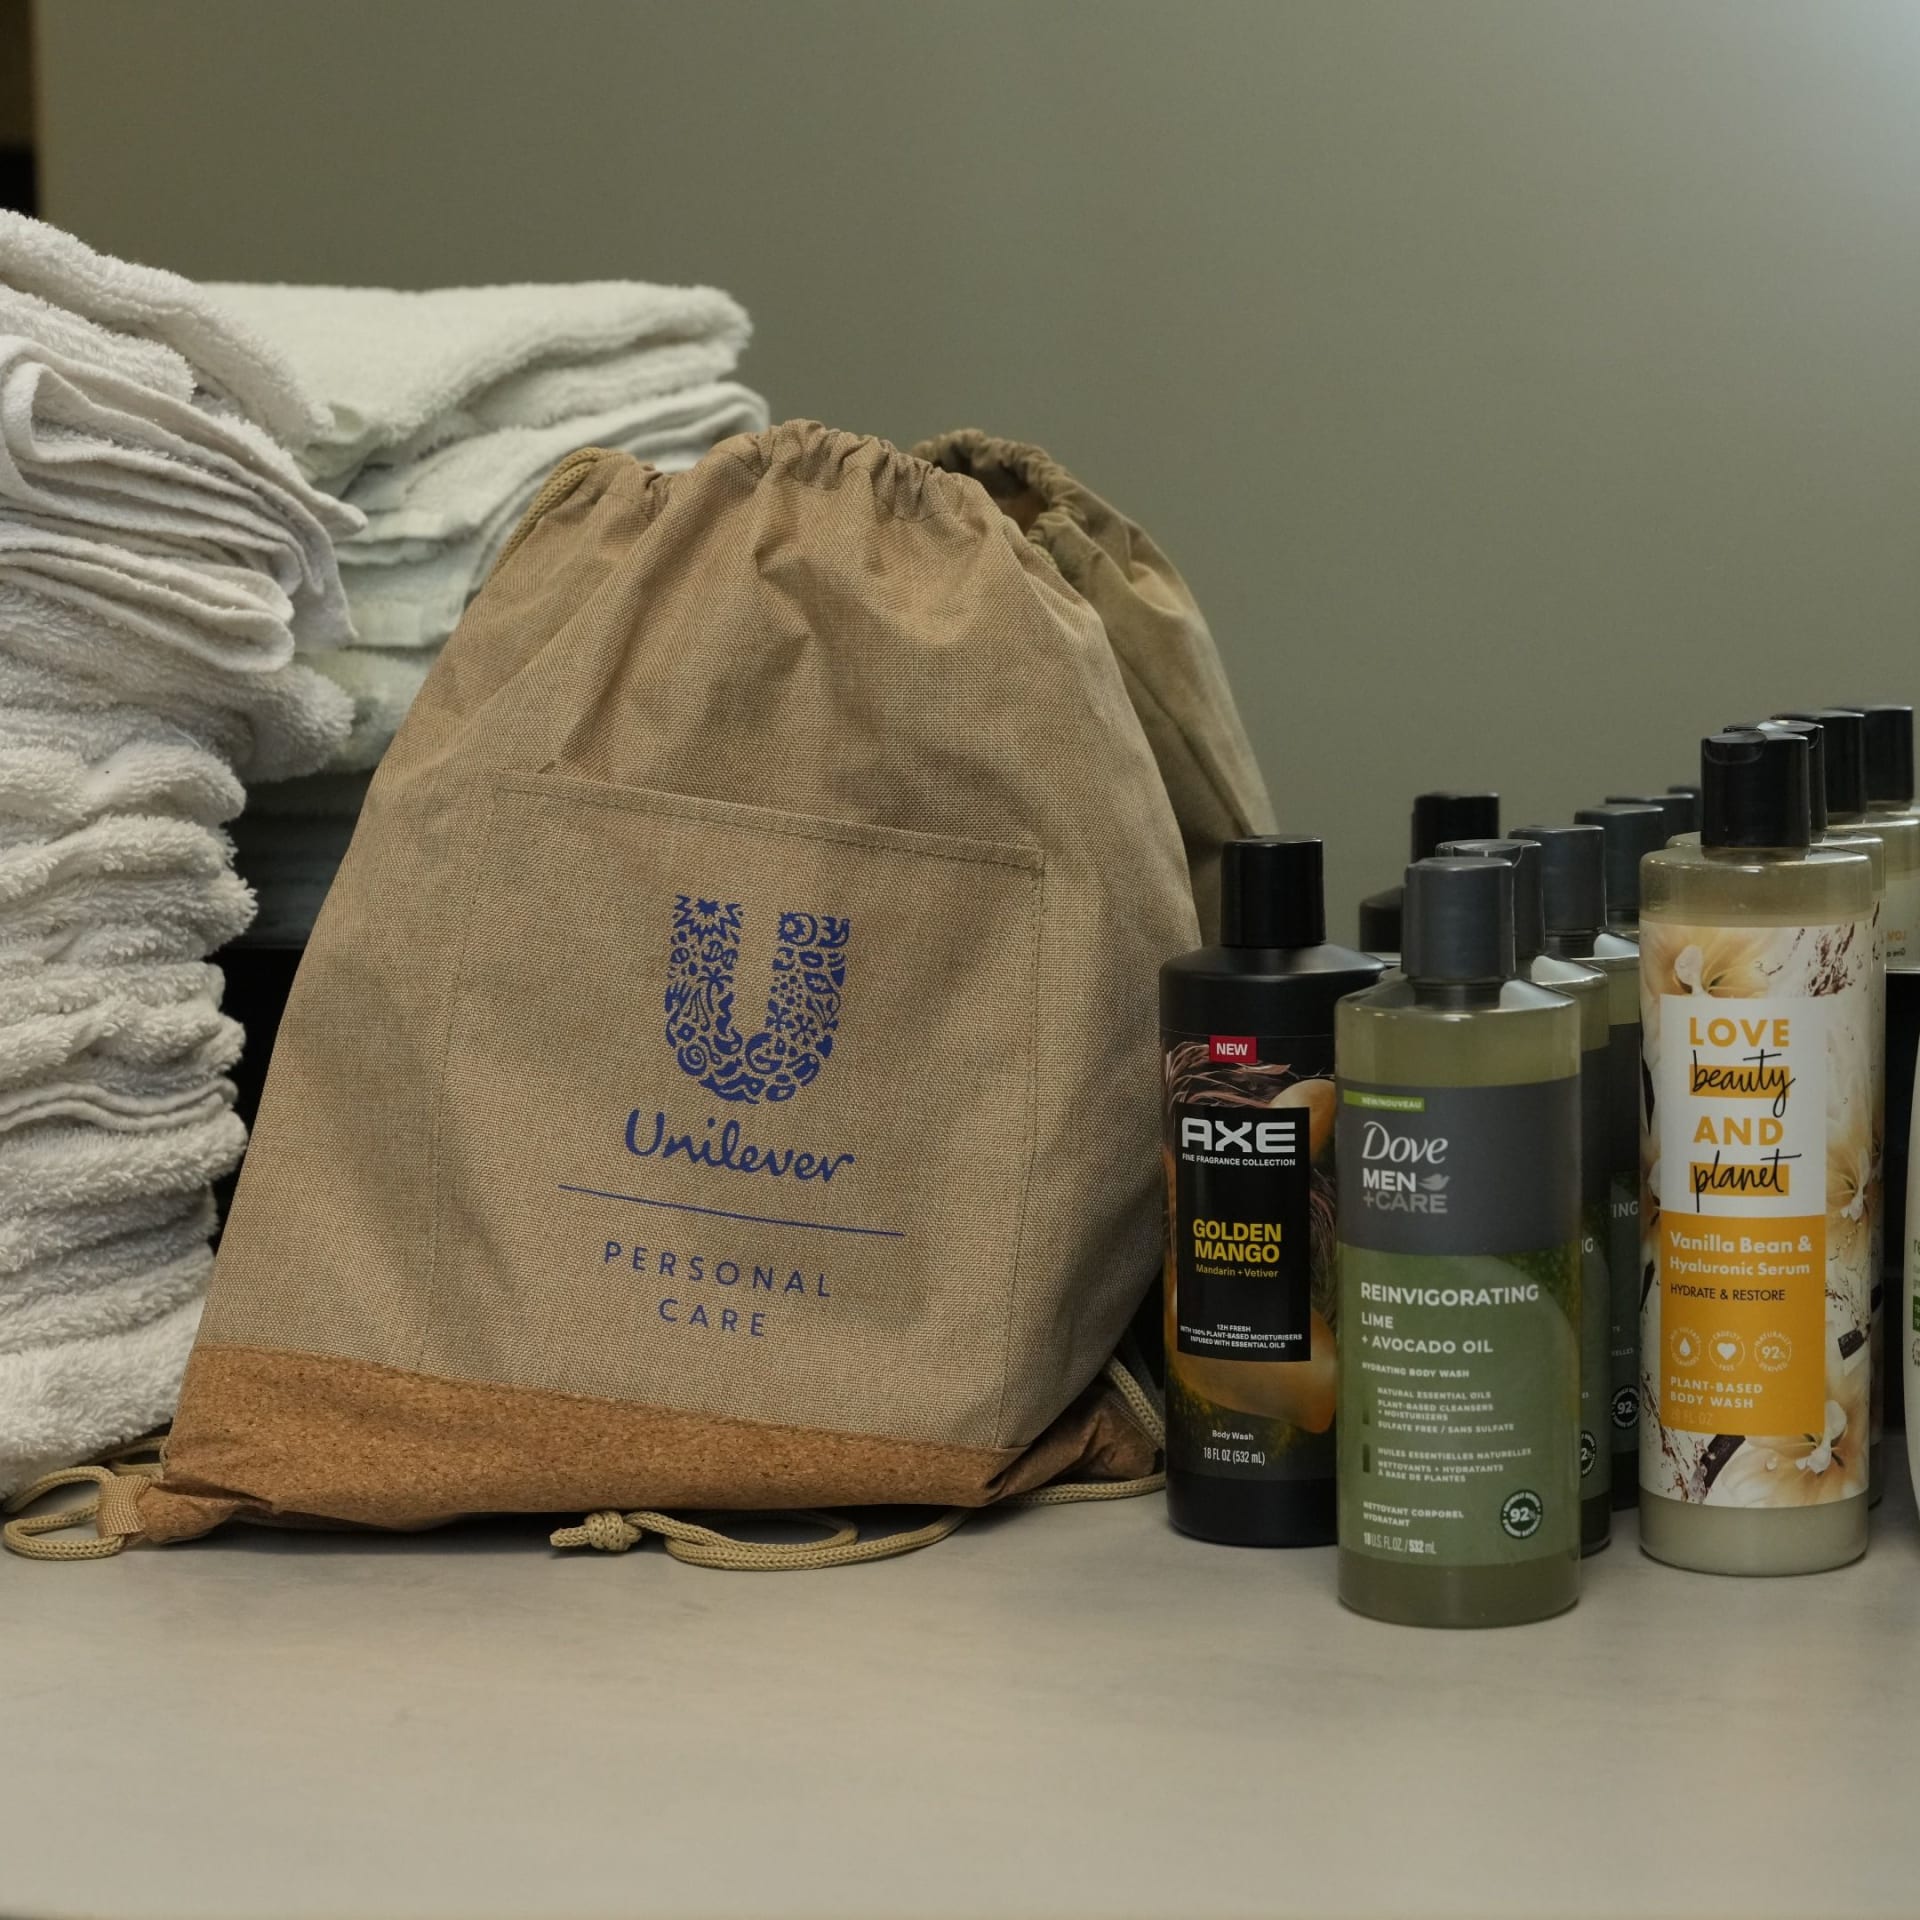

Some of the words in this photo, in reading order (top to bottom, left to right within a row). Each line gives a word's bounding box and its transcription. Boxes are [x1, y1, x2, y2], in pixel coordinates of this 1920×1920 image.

[1689, 1017, 1790, 1047] LOVE
[1216, 1043, 1248, 1056] NEW
[1692, 1049, 1796, 1118] beauty
[1182, 1117, 1296, 1153] AXE
[1693, 1116, 1784, 1145] AND
[625, 1108, 854, 1182] Unilever
[1361, 1121, 1449, 1164] Dove
[1182, 1153, 1195, 1163] FINE
[1196, 1154, 1240, 1166] FRAGRANCE
[1242, 1158, 1296, 1167] COLLECTION
[1362, 1168, 1417, 1192] MEN
[1693, 1148, 1802, 1213] planet
[1362, 1190, 1448, 1214] +CARE
[1193, 1219, 1282, 1242] GOLDEN
[1195, 1240, 1280, 1263] MANGO
[1670, 1232, 1735, 1253] Vanilla
[1740, 1236, 1793, 1254] Bean
[1797, 1235, 1812, 1252] &
[604, 1241, 831, 1298] PERSONAL
[1196, 1263, 1235, 1277] Mandarin
[1244, 1268, 1279, 1278] Vetiver
[1670, 1255, 1754, 1276] Hyaluronic
[1757, 1261, 1810, 1276] Serum
[1361, 1282, 1539, 1306] REINVIGORATING
[1671, 1283, 1716, 1299] HYDRATE
[1720, 1290, 1728, 1299] &
[1733, 1289, 1785, 1301] RESTORE
[659, 1298, 766, 1337] CARE
[1361, 1312, 1394, 1329] LIME
[1206, 1330, 1249, 1340] PLANT-BASED
[1250, 1333, 1303, 1341] MOISTURISERS
[1216, 1323, 1229, 1331] 12H
[1191, 1335, 1213, 1344] INFUSED
[1214, 1339, 1230, 1347] WITH
[1231, 1341, 1268, 1349] ESSENTIAL
[1372, 1336, 1457, 1354] AVOCADO
[1462, 1340, 1494, 1353] OIL
[1361, 1362, 1406, 1376] HYDRATING
[1409, 1368, 1436, 1378] BODY
[1439, 1369, 1470, 1378] WASH
[1670, 1375, 1764, 1394] PLANT-BASED
[1377, 1387, 1414, 1399] NATURAL
[1416, 1391, 1467, 1401] ESSENTIAL
[1470, 1391, 1492, 1399] OILS
[1670, 1391, 1704, 1405] BODY
[1710, 1396, 1754, 1409] WASH
[1377, 1400, 1436, 1412] PLANT-BASED
[1439, 1403, 1494, 1412] CLEANSERS
[1384, 1410, 1448, 1421] MOISTURIZERS
[1212, 1430, 1230, 1441] Body
[1232, 1431, 1254, 1441] Wash
[1378, 1421, 1412, 1432] SULFATE
[1415, 1425, 1438, 1434] FREE
[1448, 1425, 1473, 1434] SANS
[1475, 1423, 1514, 1434] SULFATE
[1204, 1447, 1212, 1459] 18
[1212, 1449, 1221, 1461] FL
[1222, 1449, 1231, 1462] OZ
[1232, 1450, 1250, 1464] (532
[1251, 1452, 1265, 1465] mL)
[1378, 1447, 1406, 1458] HUILES
[1408, 1451, 1474, 1461] ESSENTIELLES
[1378, 1460, 1432, 1473] NETTOYANTS
[1442, 1464, 1504, 1474] HYDRATANTS
[1385, 1471, 1406, 1480] BASE
[1409, 1473, 1421, 1481] DE
[1424, 1474, 1466, 1483] PLANTES
[1363, 1501, 1409, 1515] NETTOYANT
[1411, 1508, 1464, 1519] CORPOREL
[1363, 1512, 1410, 1527] HYDRATANT
